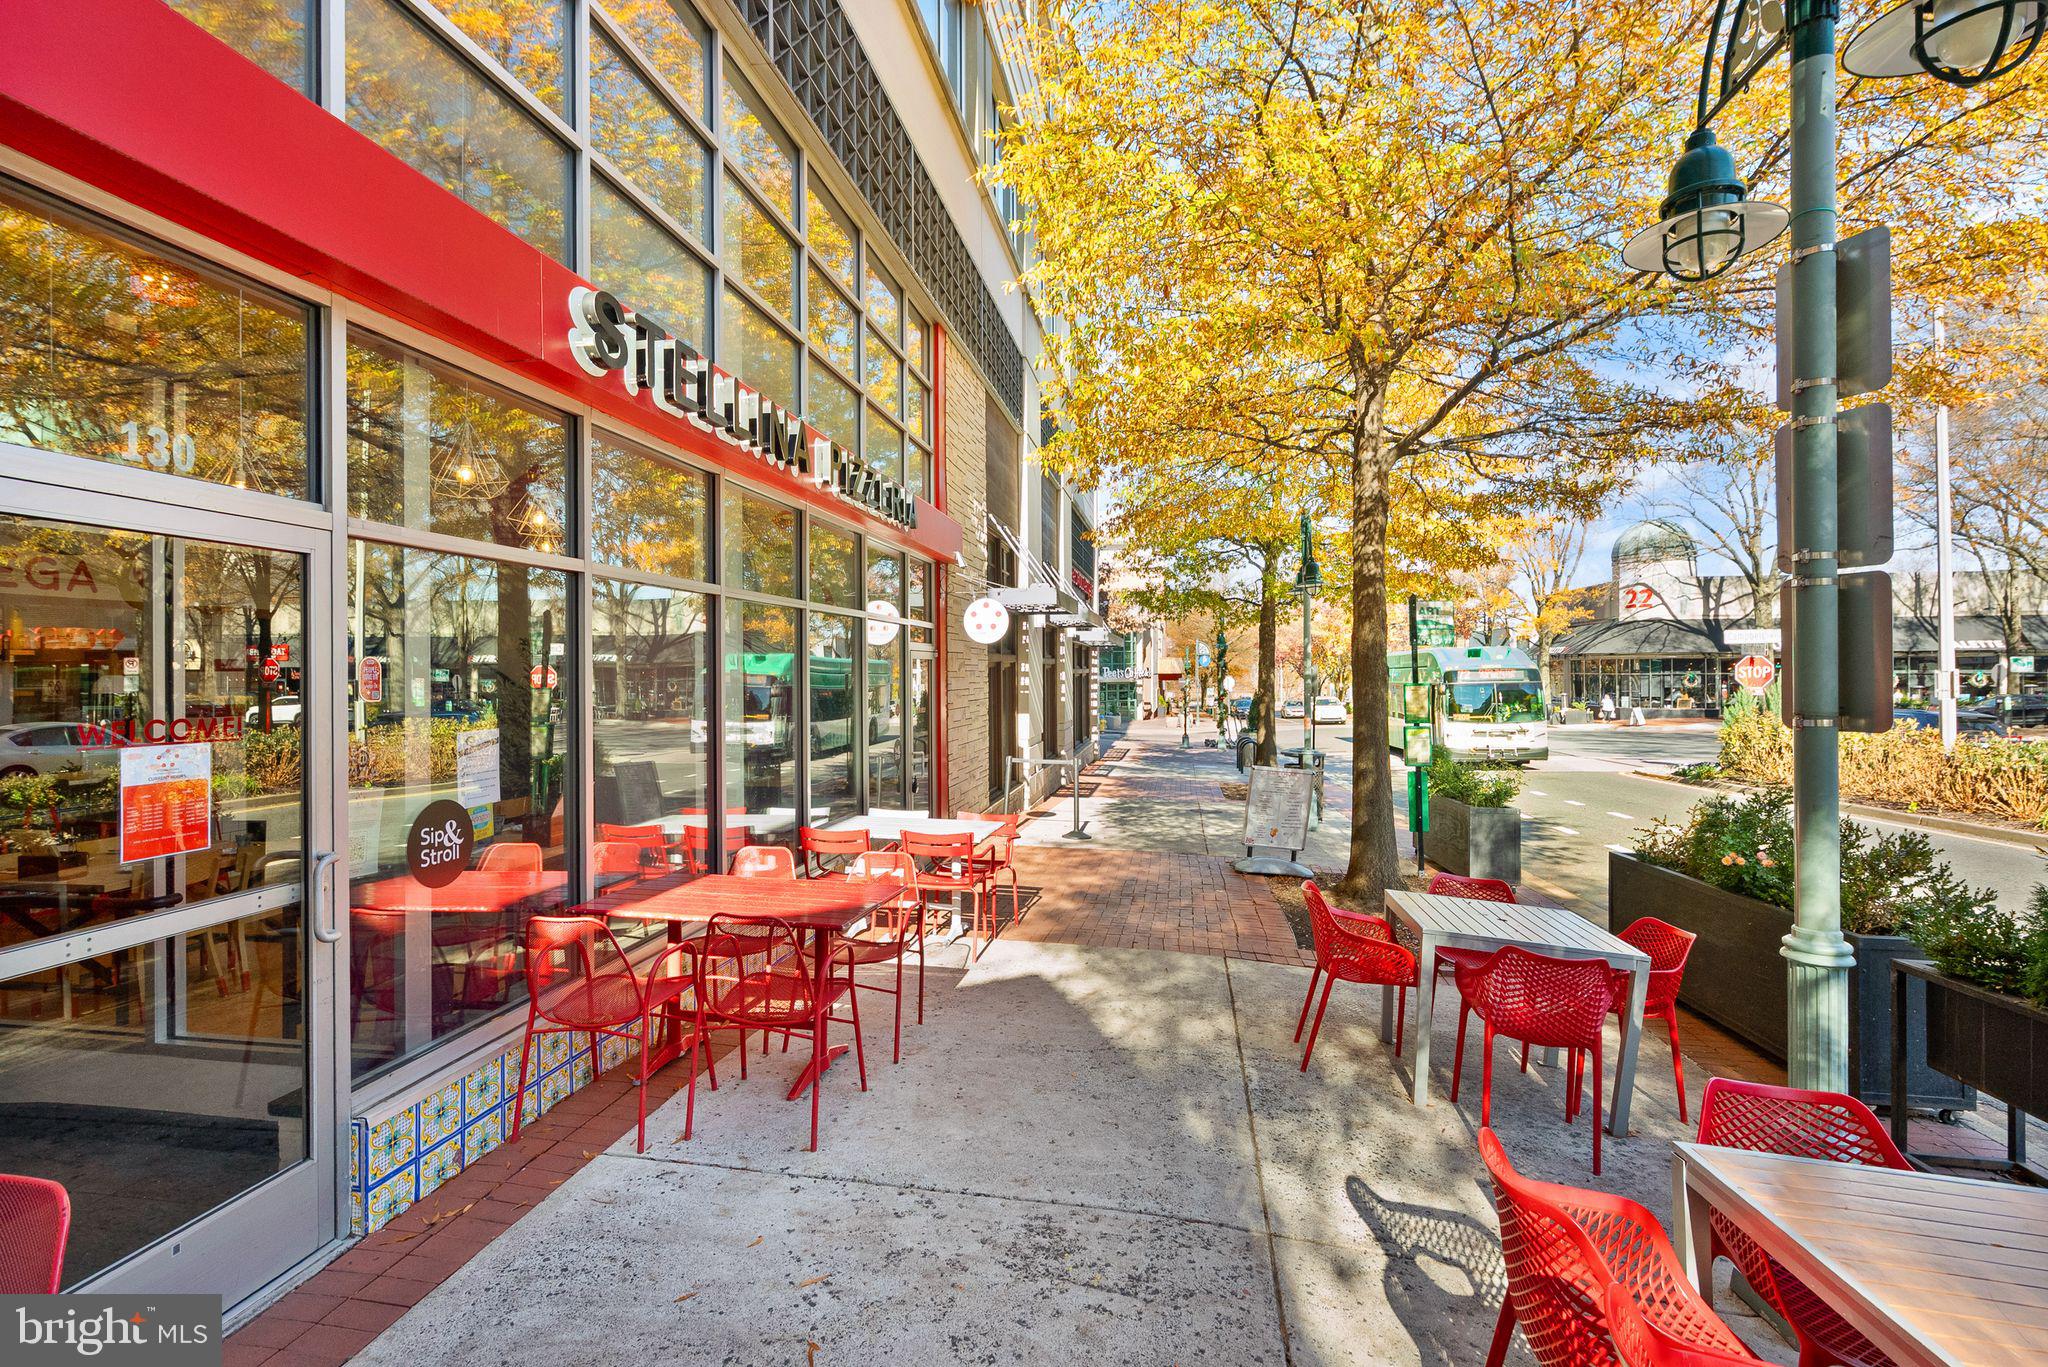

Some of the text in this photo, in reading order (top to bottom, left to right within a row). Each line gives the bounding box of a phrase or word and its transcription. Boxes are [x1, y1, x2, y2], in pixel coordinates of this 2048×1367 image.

[568, 286, 917, 532] STELLINA PIZZERIA
[121, 420, 196, 472] 130
[1625, 588, 1654, 609] 22
[1419, 606, 1441, 615] ART
[1953, 640, 2006, 649] ALETTE
[1739, 666, 1771, 679] STOP
[76, 716, 243, 747] WELCOME!
[420, 844, 460, 868] Stroll
